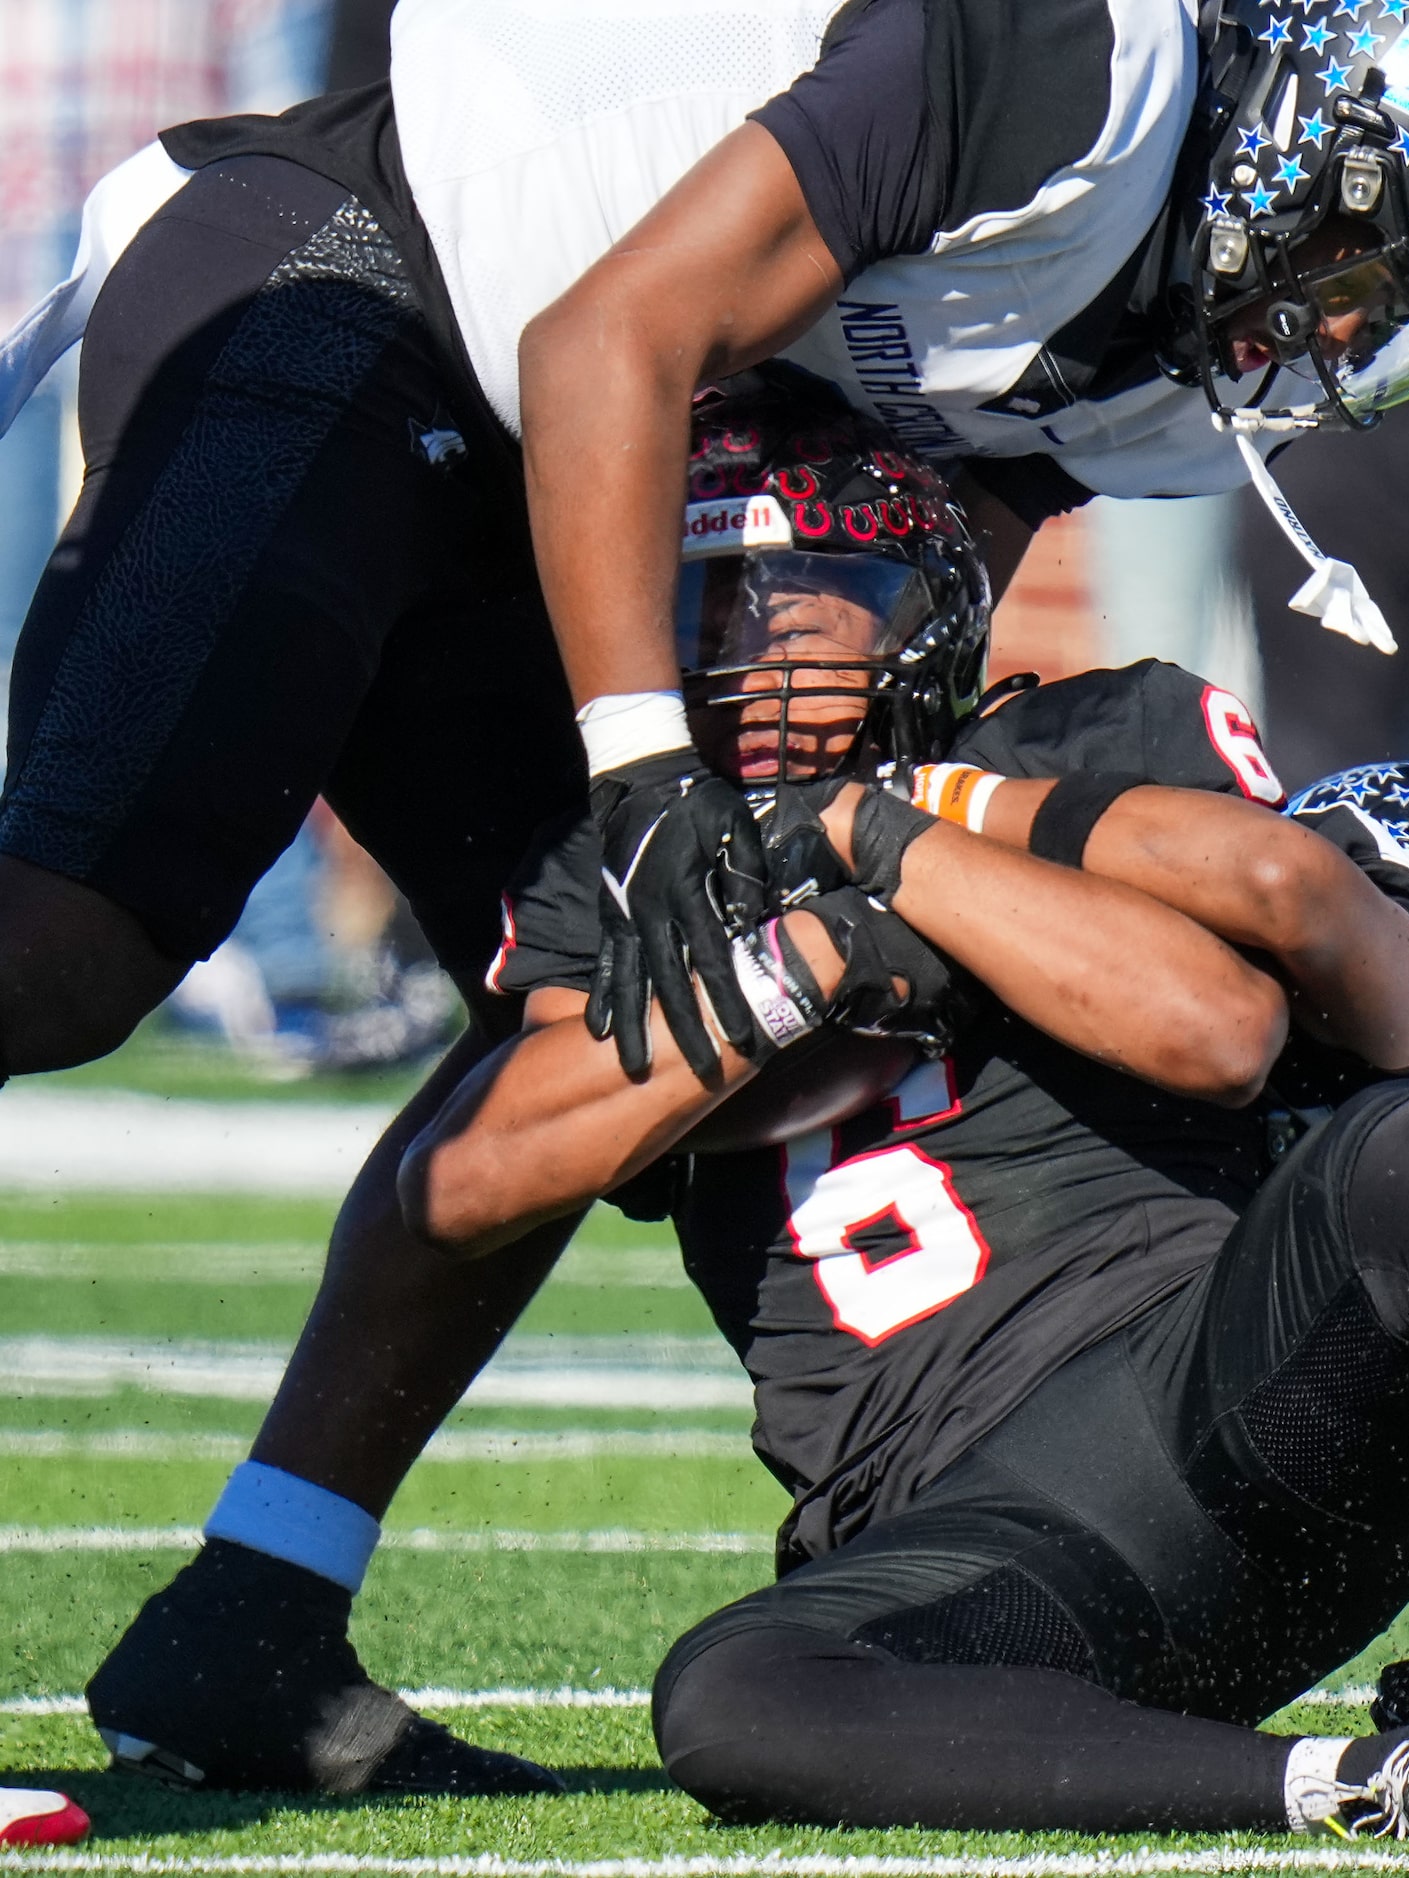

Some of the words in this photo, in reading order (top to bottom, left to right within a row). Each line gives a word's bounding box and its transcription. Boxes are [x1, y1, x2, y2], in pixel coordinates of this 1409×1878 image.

[836, 300, 926, 397] NORTH
[1200, 685, 1287, 809] 6
[781, 1056, 993, 1349] 6
